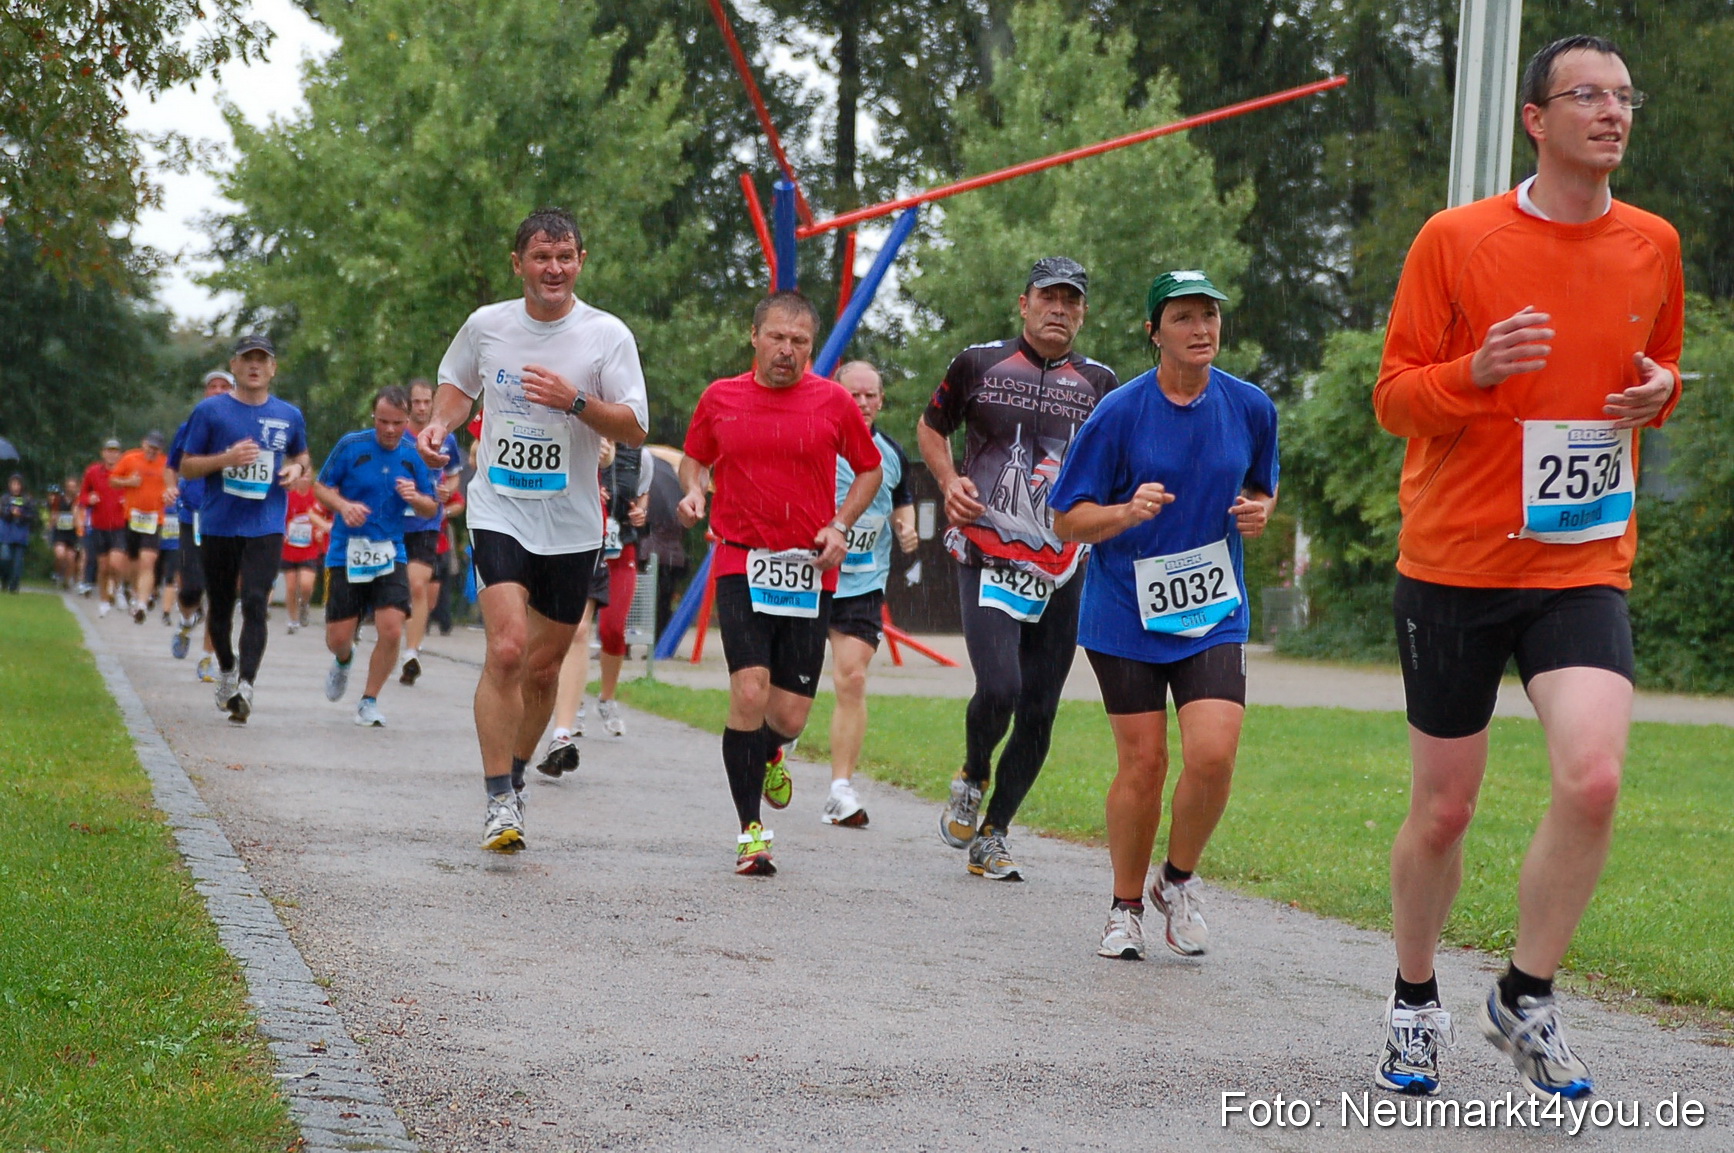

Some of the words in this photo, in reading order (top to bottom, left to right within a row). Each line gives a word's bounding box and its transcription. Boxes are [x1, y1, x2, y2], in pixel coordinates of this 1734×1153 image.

[976, 391, 1093, 422] SELIGENPORTE
[983, 376, 1096, 409] KLOSTERBIKER
[497, 438, 561, 470] 2388
[227, 463, 268, 481] 3315
[508, 475, 543, 488] Hubert
[1538, 446, 1622, 499] 2536
[1559, 505, 1602, 527] Roland
[752, 559, 815, 590] 2559
[990, 567, 1048, 599] 3426
[1148, 567, 1227, 613] 3032
[762, 591, 800, 606] Thomas
